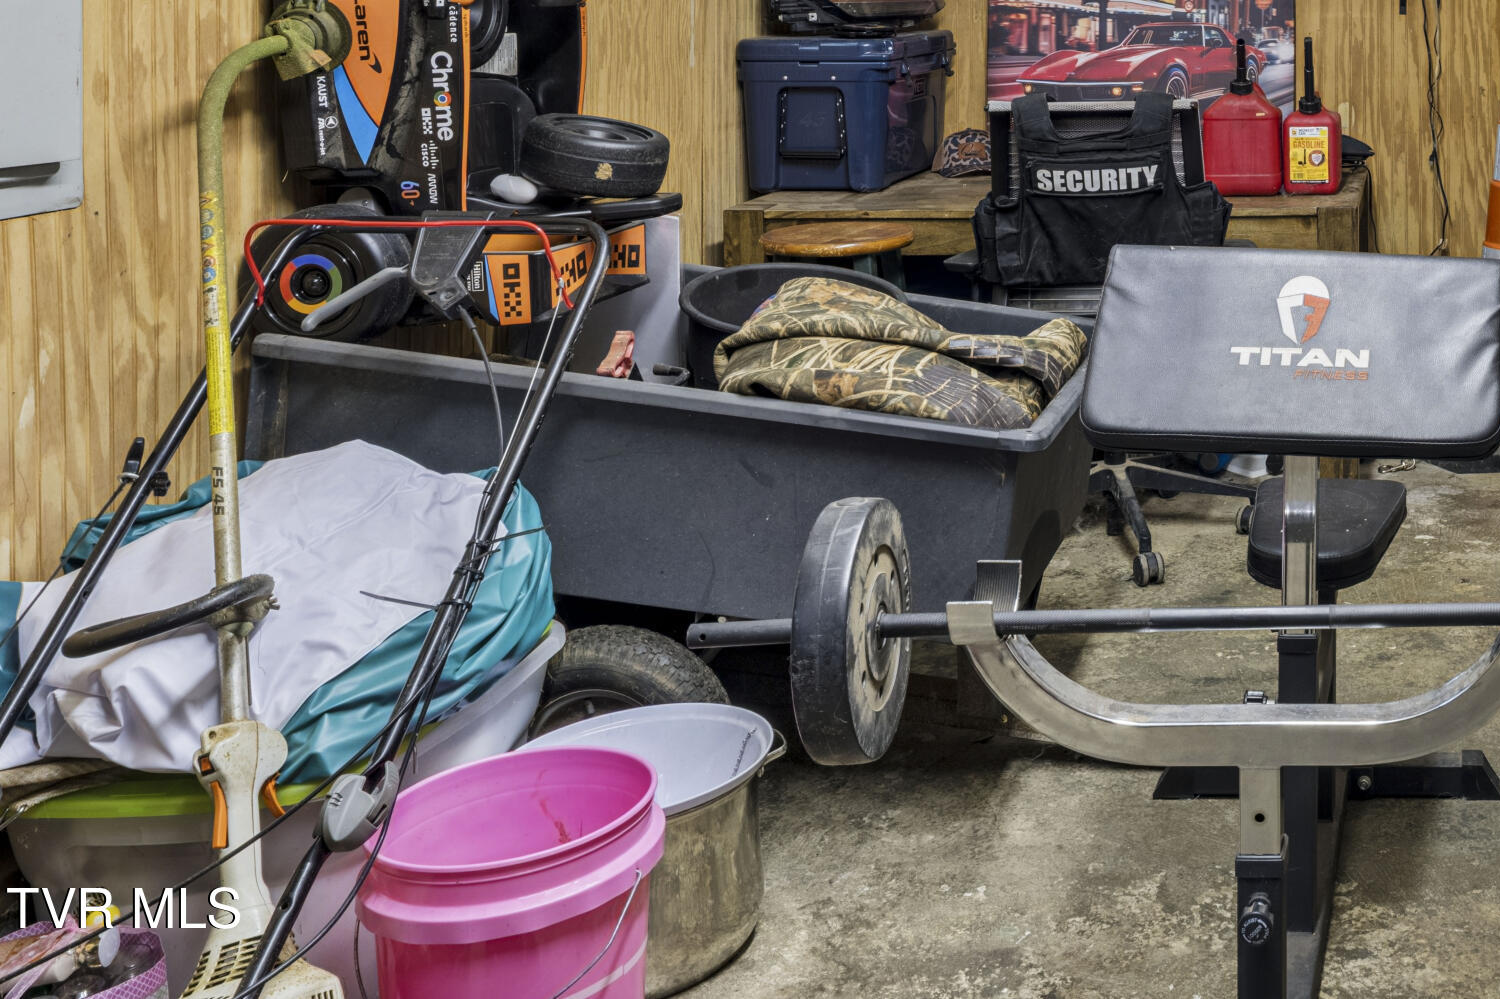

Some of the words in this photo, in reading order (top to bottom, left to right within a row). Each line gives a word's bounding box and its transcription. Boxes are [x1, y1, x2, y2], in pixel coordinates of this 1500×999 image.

[316, 76, 328, 107] KAUST
[431, 51, 454, 141] Chrome
[1293, 140, 1325, 149] GASOLINE
[1036, 164, 1158, 192] SECURITY
[473, 263, 482, 291] Hilton
[1230, 346, 1370, 368] TITAN
[1293, 369, 1369, 381] FITNESS
